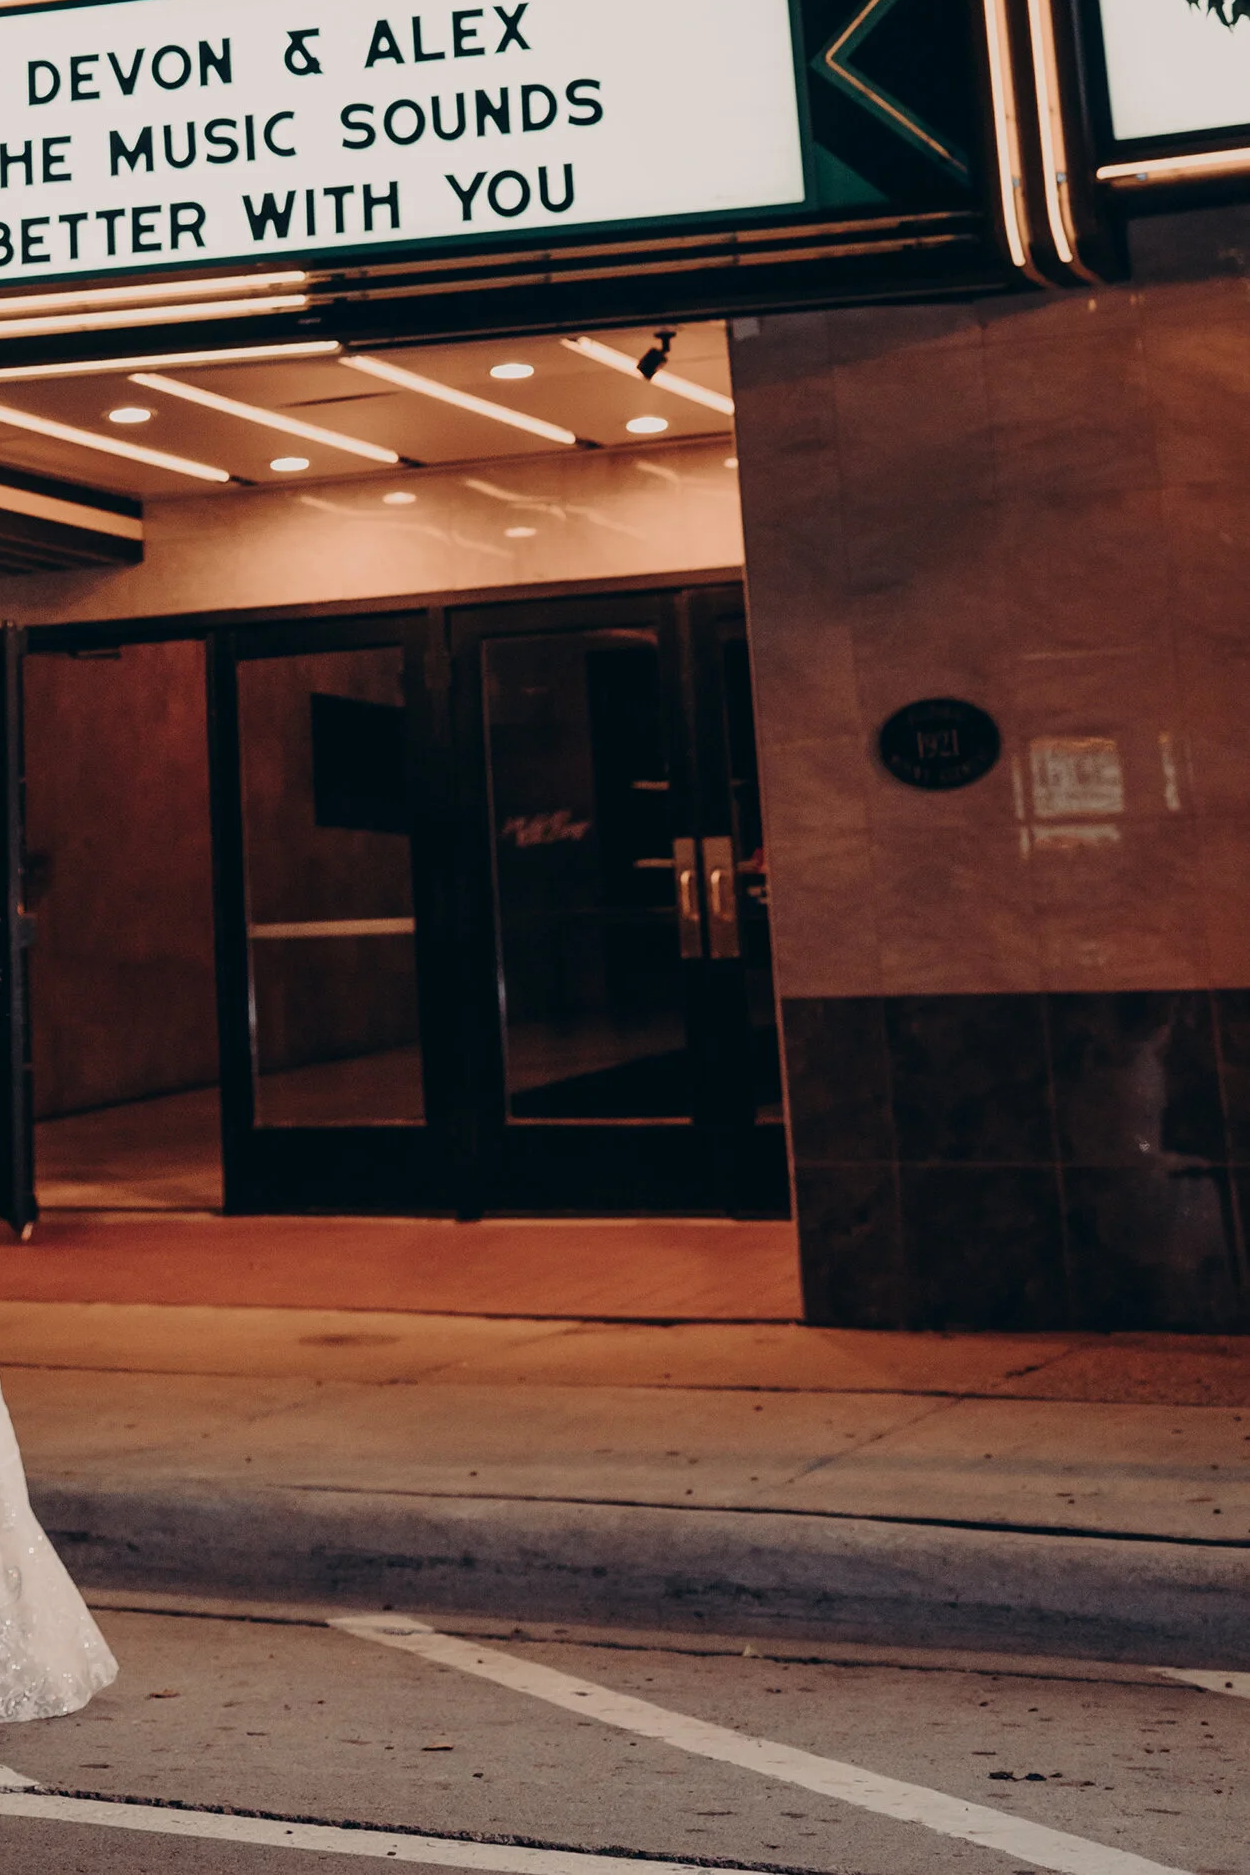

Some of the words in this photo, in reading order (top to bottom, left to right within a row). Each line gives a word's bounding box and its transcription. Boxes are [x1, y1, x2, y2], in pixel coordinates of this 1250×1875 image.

[27, 37, 233, 106] DEVON
[284, 27, 323, 76] &
[364, 2, 531, 69] ALEX
[109, 110, 297, 177] MUSIC
[340, 78, 604, 150] SOUNDS
[241, 180, 401, 241] WITH
[444, 163, 575, 222] YOU
